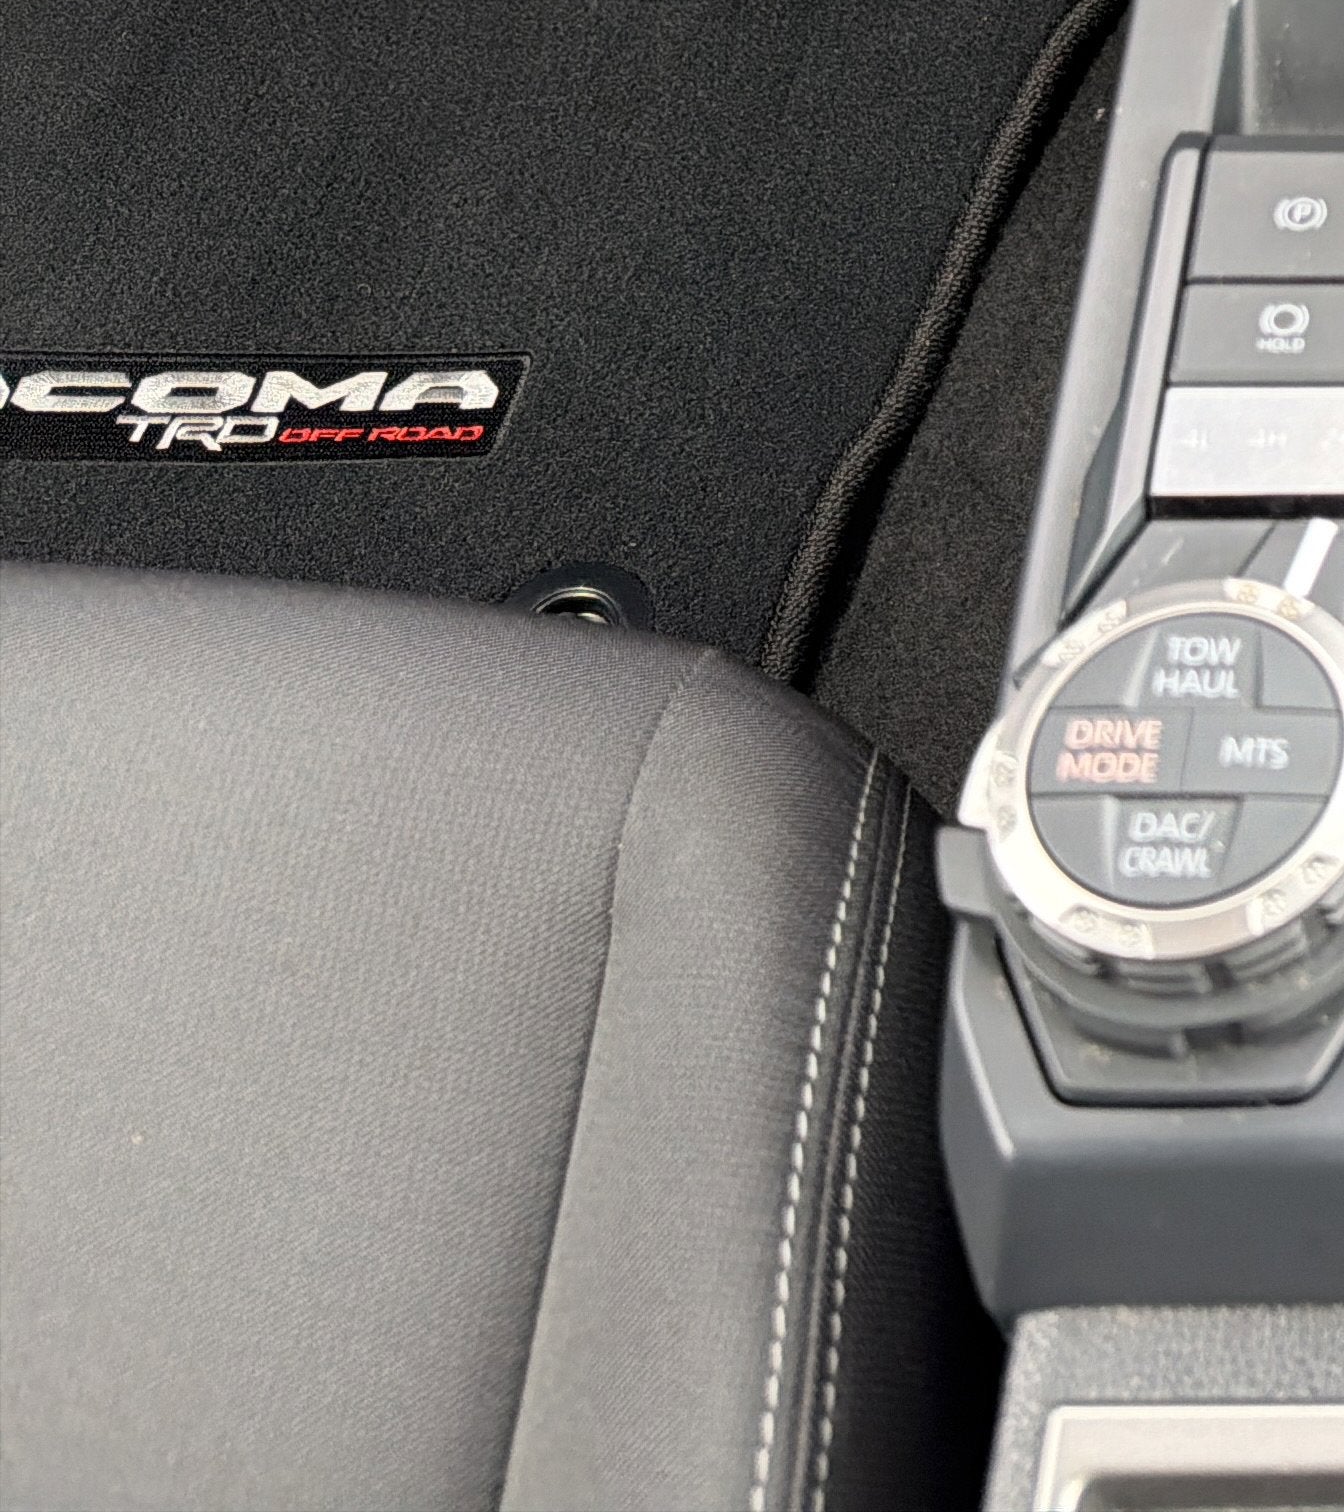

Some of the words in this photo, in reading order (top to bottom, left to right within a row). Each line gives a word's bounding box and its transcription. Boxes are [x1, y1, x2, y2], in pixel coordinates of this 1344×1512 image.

[1256, 337, 1306, 354] HOLD
[0, 369, 499, 414] COMA
[115, 415, 280, 452] TRD
[278, 426, 364, 443] OFF
[367, 424, 485, 444] ROAD
[1166, 636, 1242, 667] TOW
[1152, 668, 1241, 699] HAUL
[1065, 719, 1162, 750] DRIVE
[1056, 752, 1159, 783] MODE
[1218, 737, 1290, 770] MTS
[1129, 811, 1216, 843] DAC/
[1119, 845, 1212, 878] CRAWL
